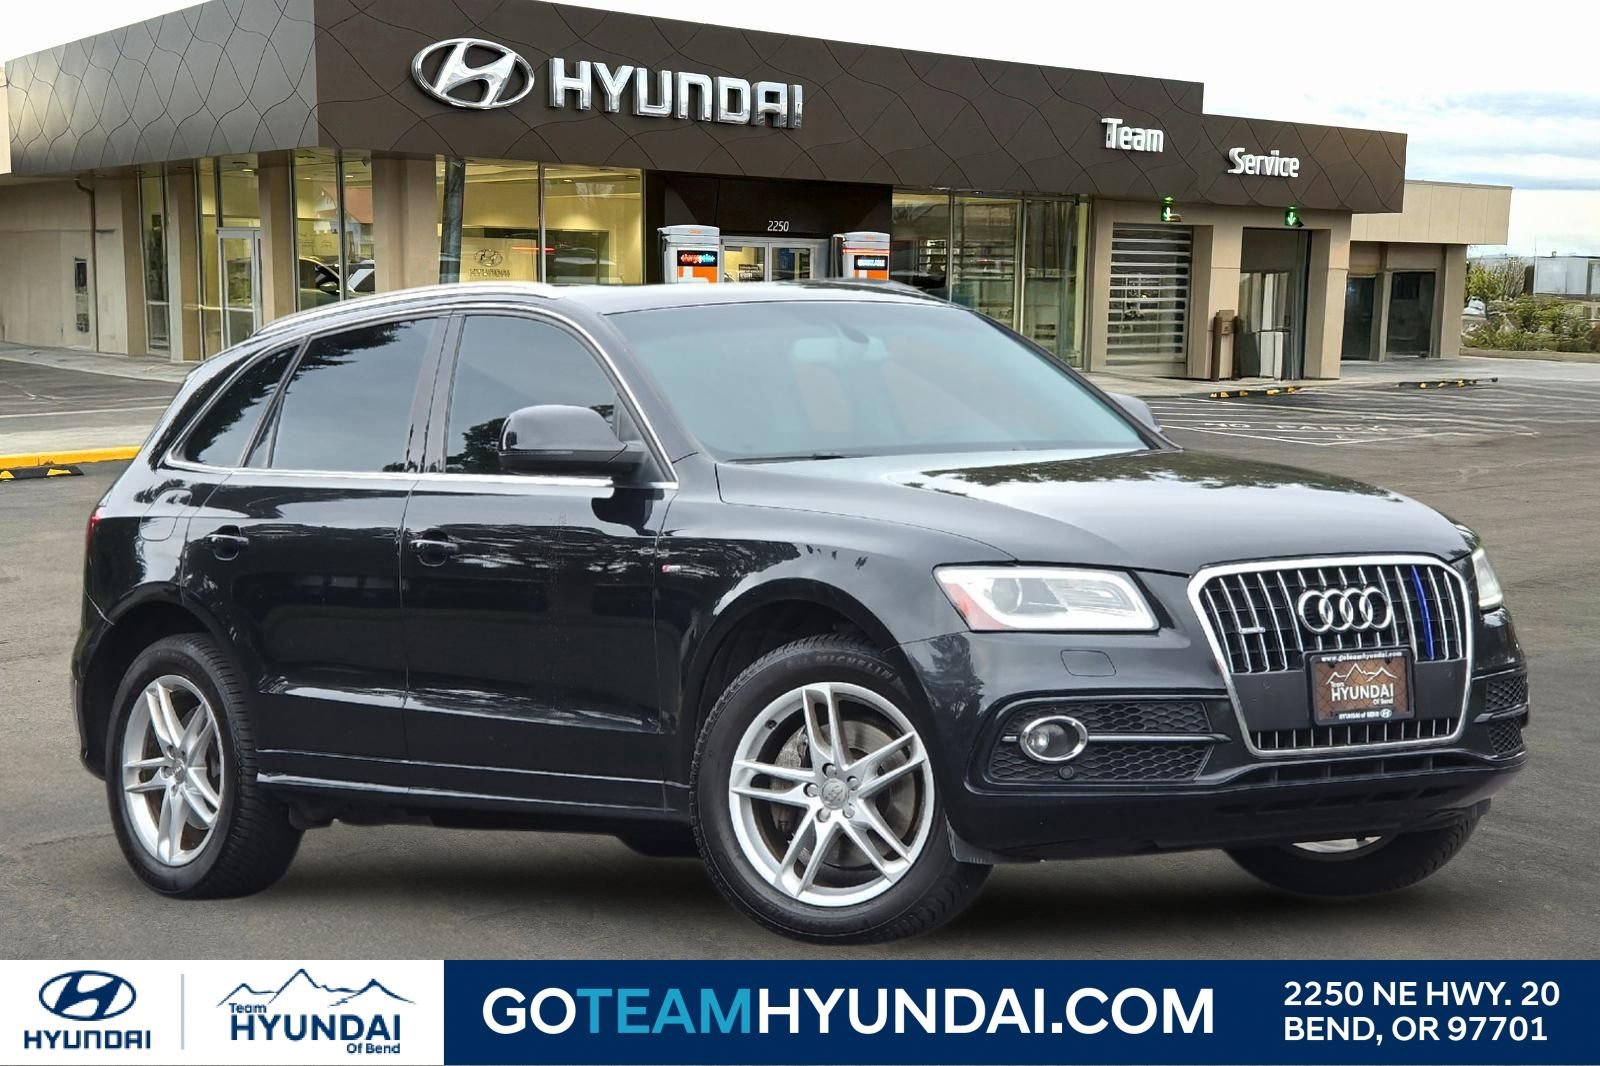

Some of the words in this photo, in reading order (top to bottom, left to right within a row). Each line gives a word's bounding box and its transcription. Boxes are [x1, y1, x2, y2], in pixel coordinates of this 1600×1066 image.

[548, 57, 804, 129] HYUNDAI
[1101, 118, 1164, 153] Team
[1227, 147, 1300, 178] Service
[767, 220, 790, 232] 2250
[1332, 684, 1394, 702] HYUNDAI
